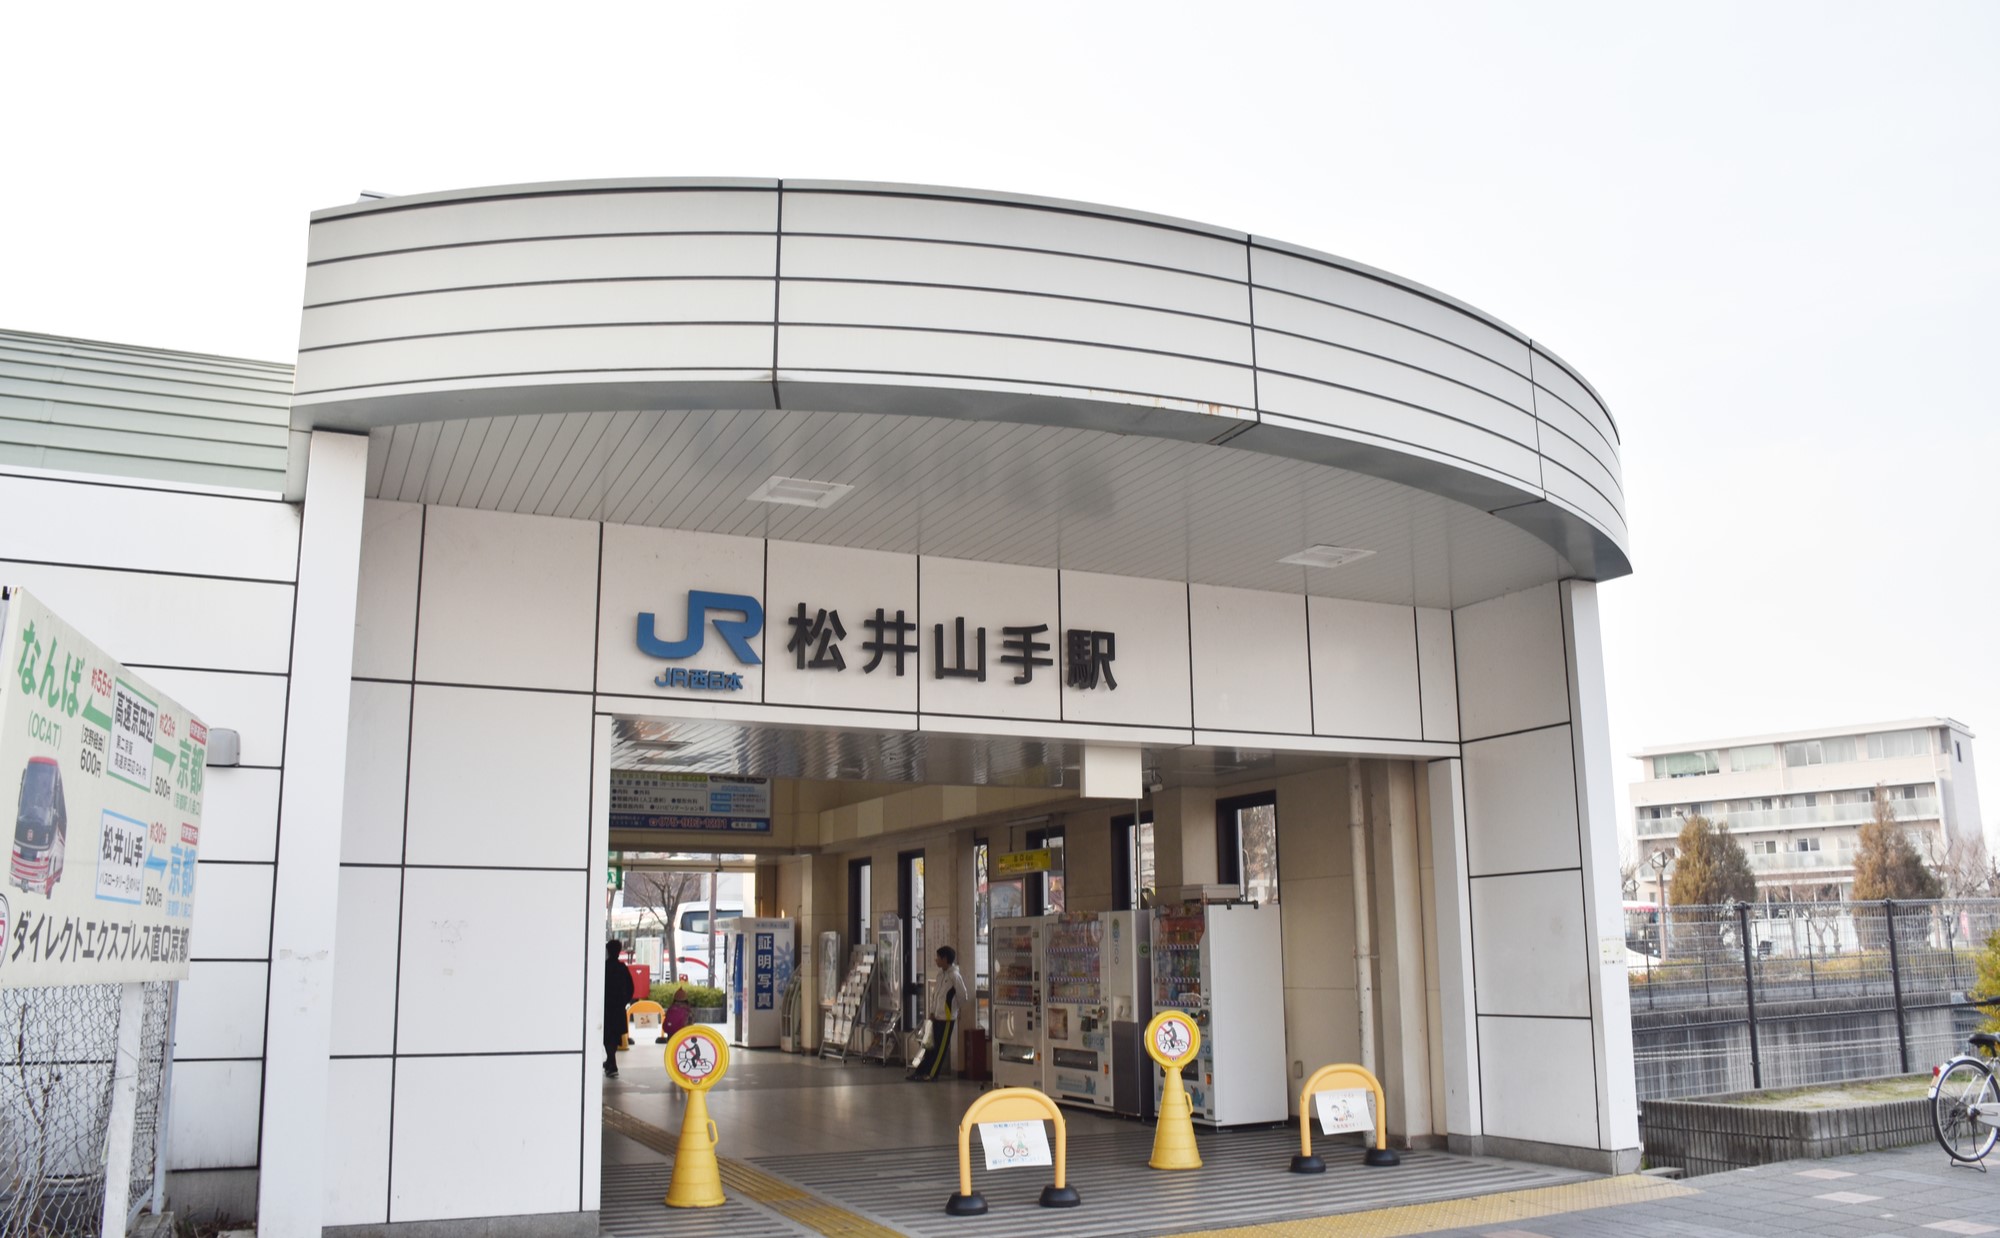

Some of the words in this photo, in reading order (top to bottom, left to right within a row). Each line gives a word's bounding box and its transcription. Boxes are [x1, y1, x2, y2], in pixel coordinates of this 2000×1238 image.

[636, 589, 764, 665] JR
[787, 602, 1118, 691] 松井山手駅
[17, 619, 86, 718] なんば
[91, 667, 112, 699] 約55分
[655, 667, 744, 691] JR西日本
[28, 709, 62, 751] (OCAT)
[114, 690, 155, 744] 高速京田辺
[80, 748, 102, 779] 600円
[154, 775, 171, 800] 500円
[176, 737, 205, 796] 京都
[103, 824, 143, 869] 松井山手
[168, 843, 196, 898] 京都
[145, 886, 162, 908] 500円
[12, 910, 190, 964] ダイレクトエクスプレス直Q京都
[757, 935, 772, 1008] 証明写真
